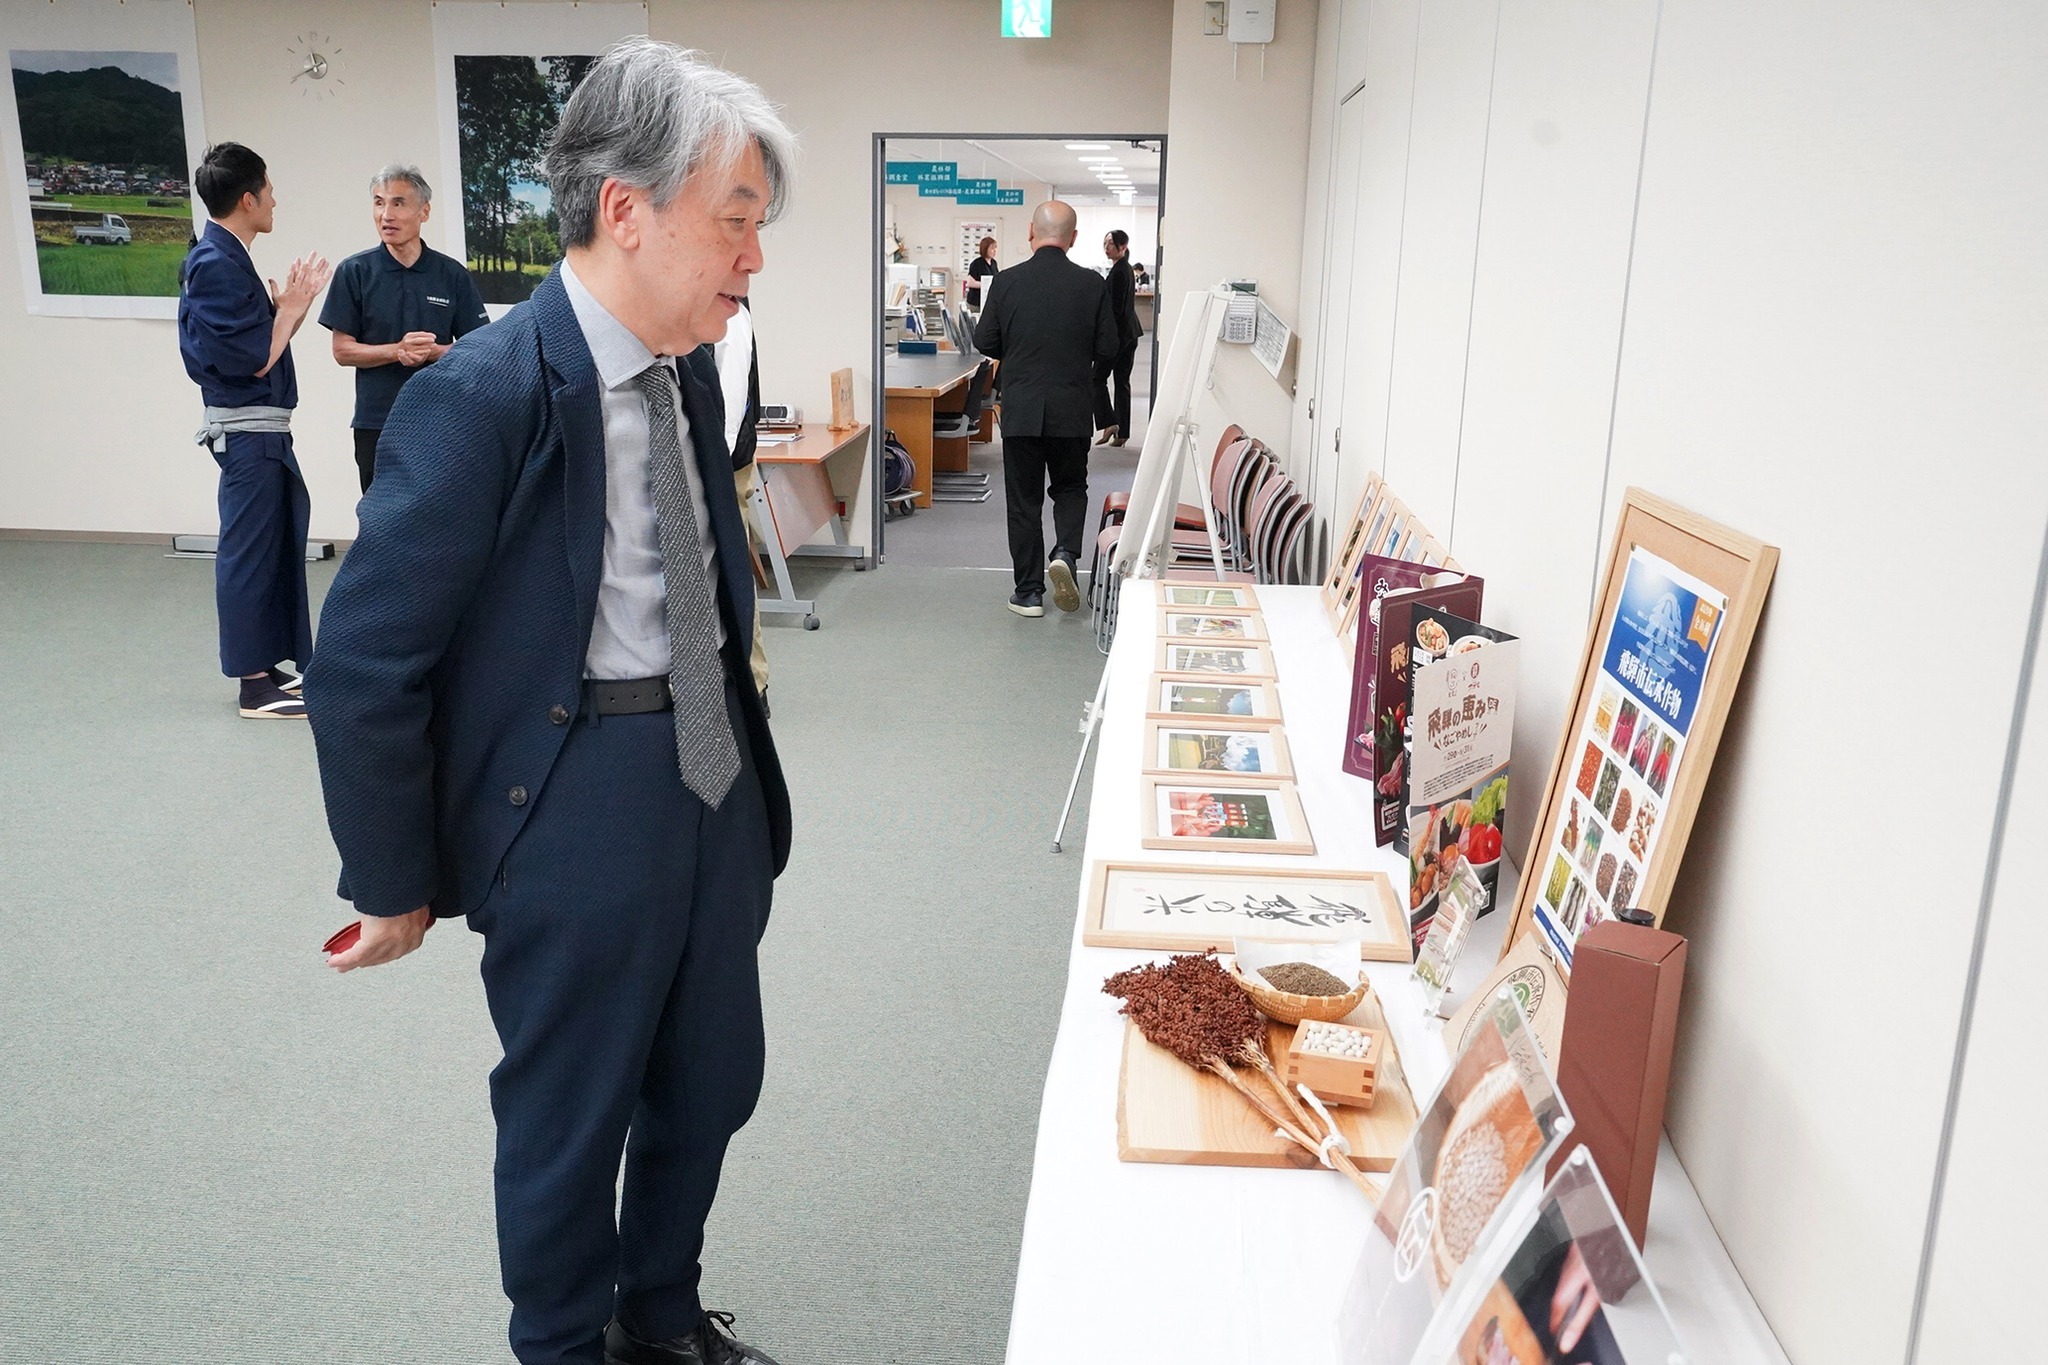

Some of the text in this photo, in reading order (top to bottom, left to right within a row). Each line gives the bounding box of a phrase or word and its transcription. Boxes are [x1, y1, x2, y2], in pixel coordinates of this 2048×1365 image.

[1617, 648, 1682, 720] 飛騨市伝承作物
[1143, 891, 1372, 927] 飛騨の米
